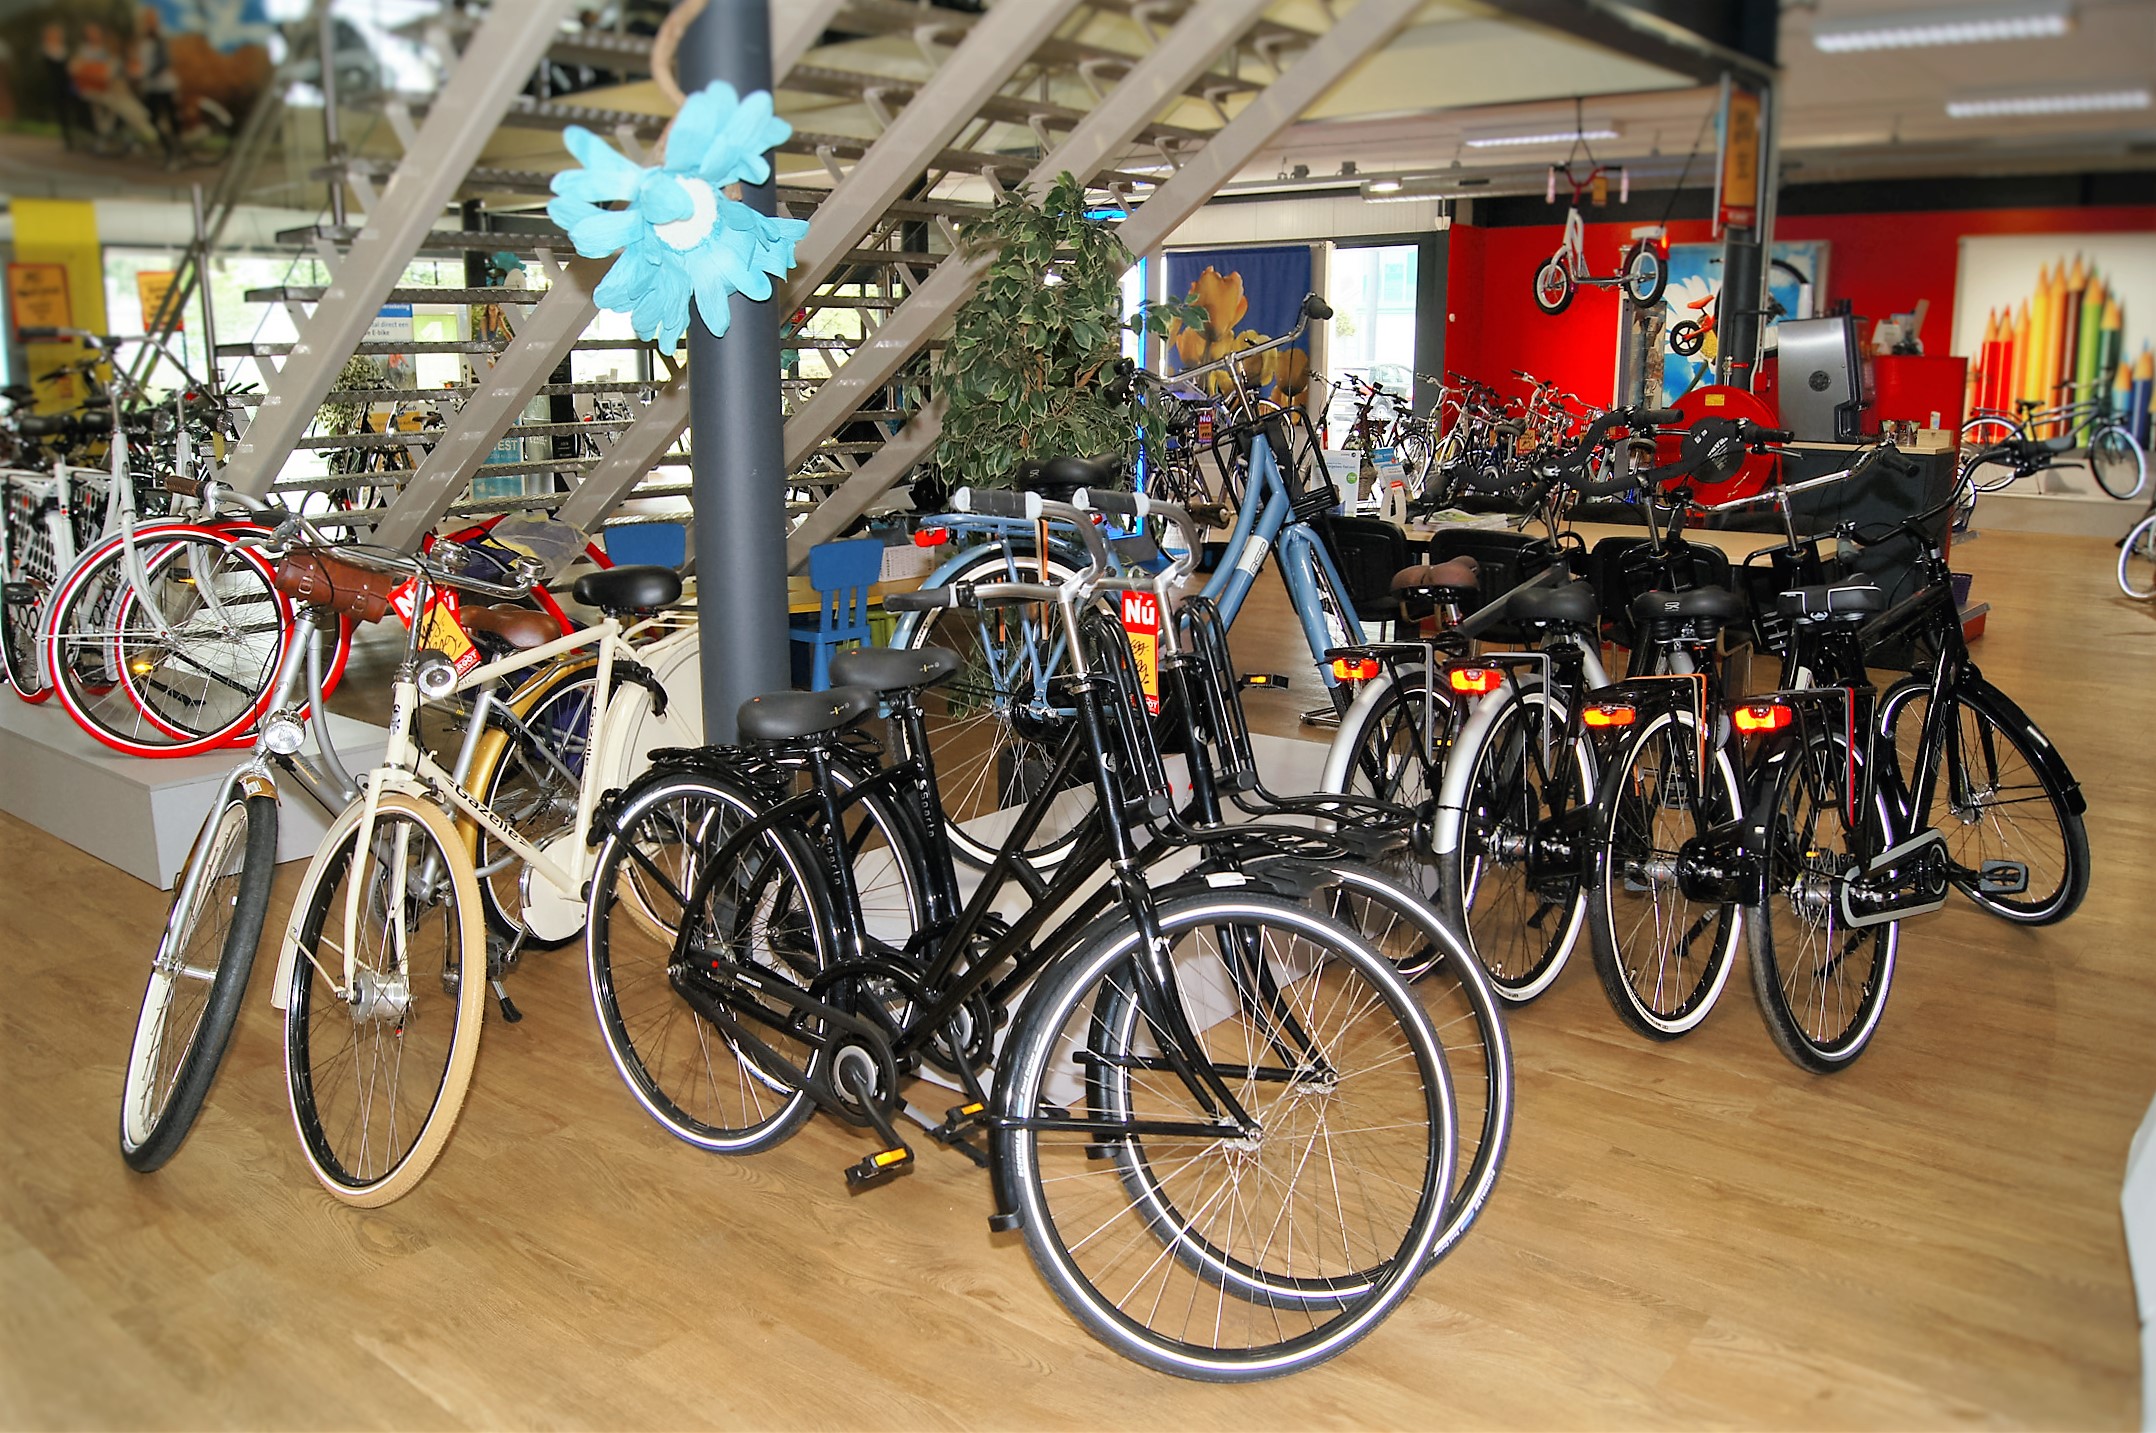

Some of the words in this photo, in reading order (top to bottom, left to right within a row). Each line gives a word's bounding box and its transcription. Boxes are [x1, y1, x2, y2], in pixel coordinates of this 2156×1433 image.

[493, 439, 518, 451] EST
[1125, 599, 1156, 625] Nú
[455, 784, 519, 841] Gazelle
[921, 791, 935, 838] Sparta
